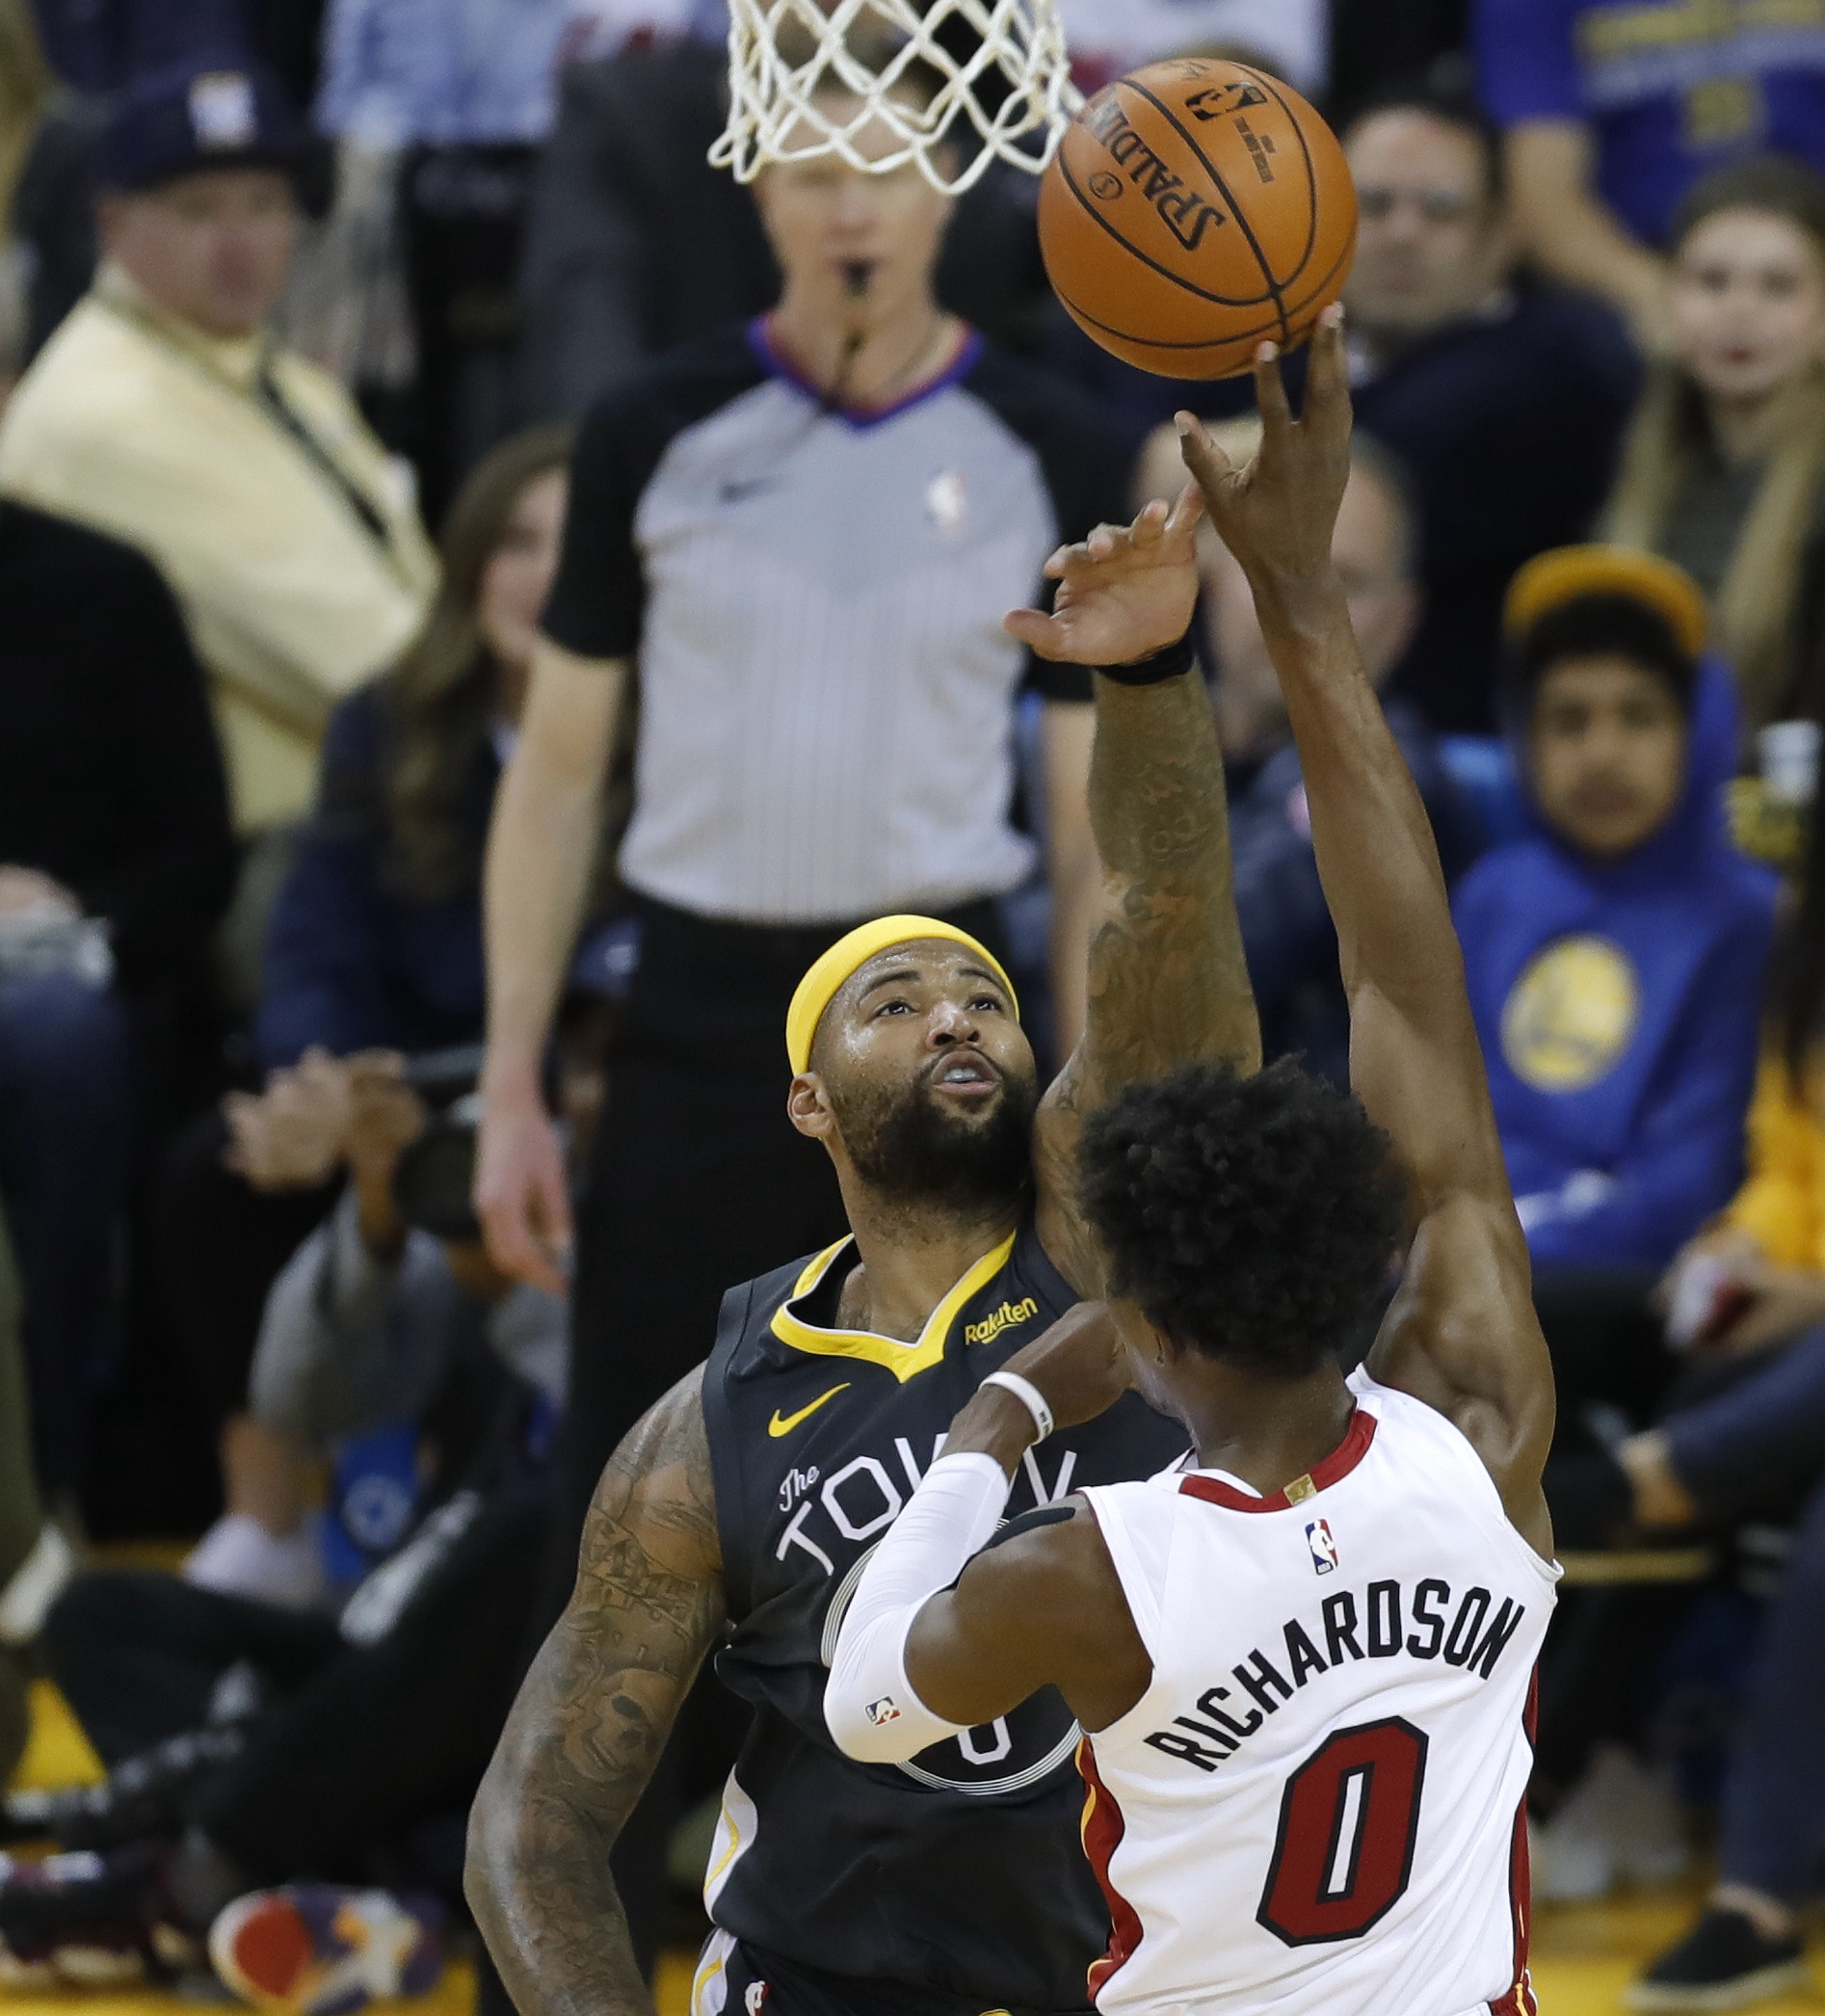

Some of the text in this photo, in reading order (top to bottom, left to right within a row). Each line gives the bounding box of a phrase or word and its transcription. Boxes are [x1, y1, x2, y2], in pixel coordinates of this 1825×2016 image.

[965, 1297, 1039, 1345] Rakuten
[779, 1465, 819, 1512] The
[1143, 1578, 1525, 1772] RICHARDSON
[1256, 1714, 1430, 1949] 0
